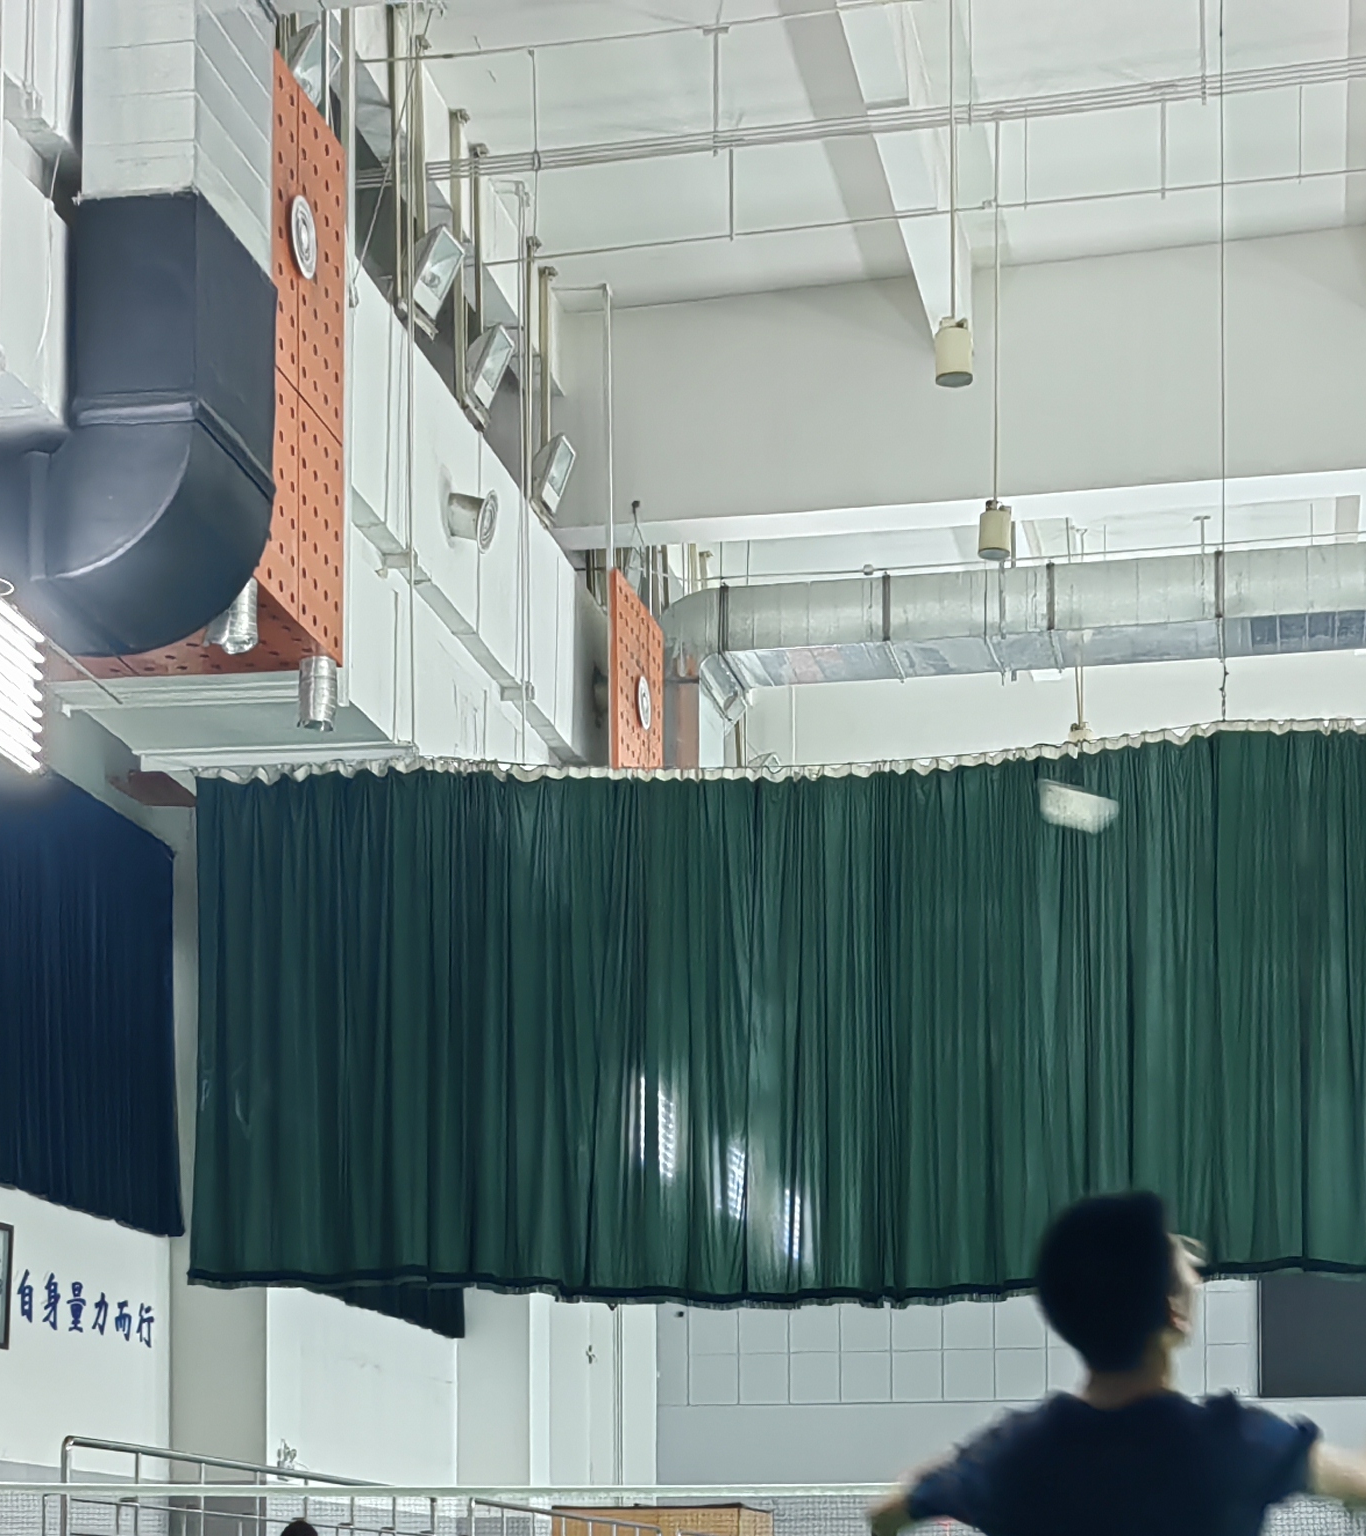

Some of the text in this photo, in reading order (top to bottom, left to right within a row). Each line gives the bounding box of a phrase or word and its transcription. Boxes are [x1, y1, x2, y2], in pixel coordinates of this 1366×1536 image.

[16, 1268, 155, 1349] 自身量力而行
